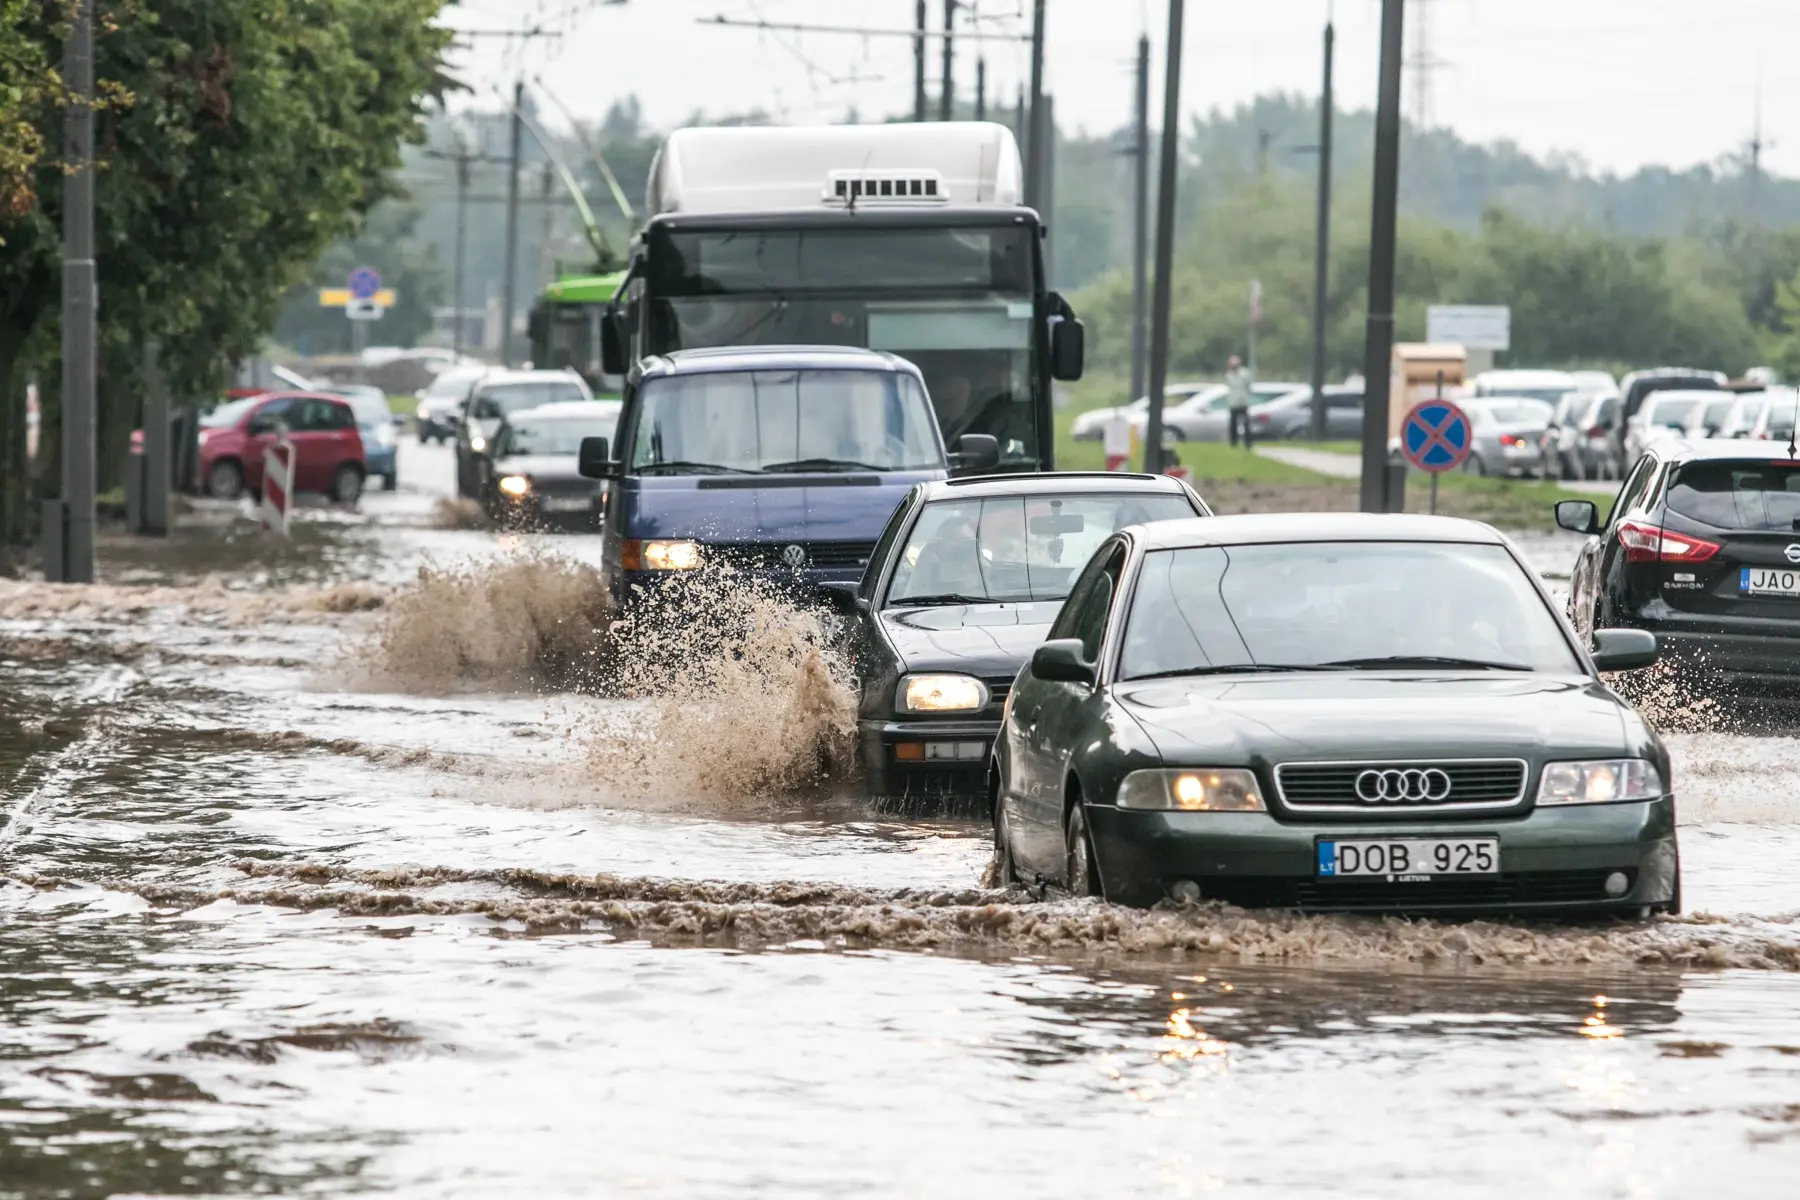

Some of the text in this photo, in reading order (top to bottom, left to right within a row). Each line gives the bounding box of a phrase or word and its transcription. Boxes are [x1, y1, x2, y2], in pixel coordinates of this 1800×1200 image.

[1753, 571, 1794, 589] JAO
[1320, 843, 1492, 873] LT DOB 925
